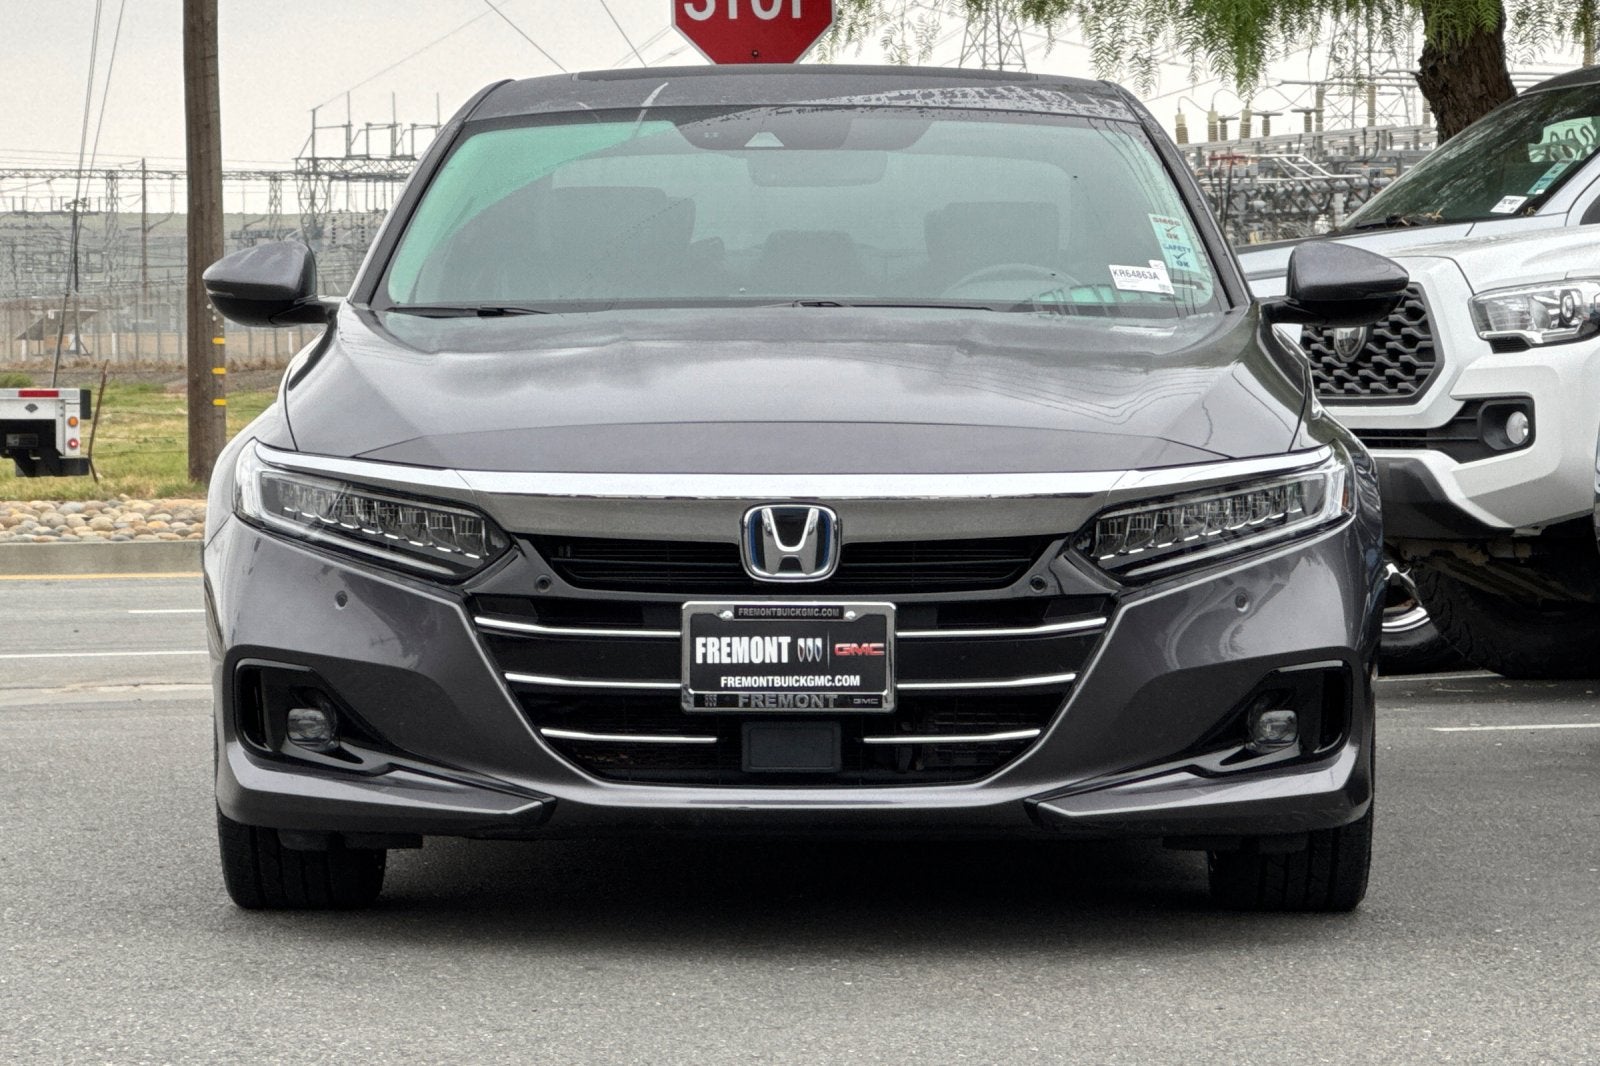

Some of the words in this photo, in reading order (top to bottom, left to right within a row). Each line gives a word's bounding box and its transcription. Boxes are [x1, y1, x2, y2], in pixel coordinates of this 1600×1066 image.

[1112, 269, 1160, 281] KR64863A
[738, 607, 839, 617] FREMONTBUICKGMC.COM
[695, 636, 791, 664] FREMONT
[834, 643, 884, 656] GMC
[720, 675, 860, 687] FREMONTBUICKGMC.COM
[738, 694, 839, 708] FREMONT
